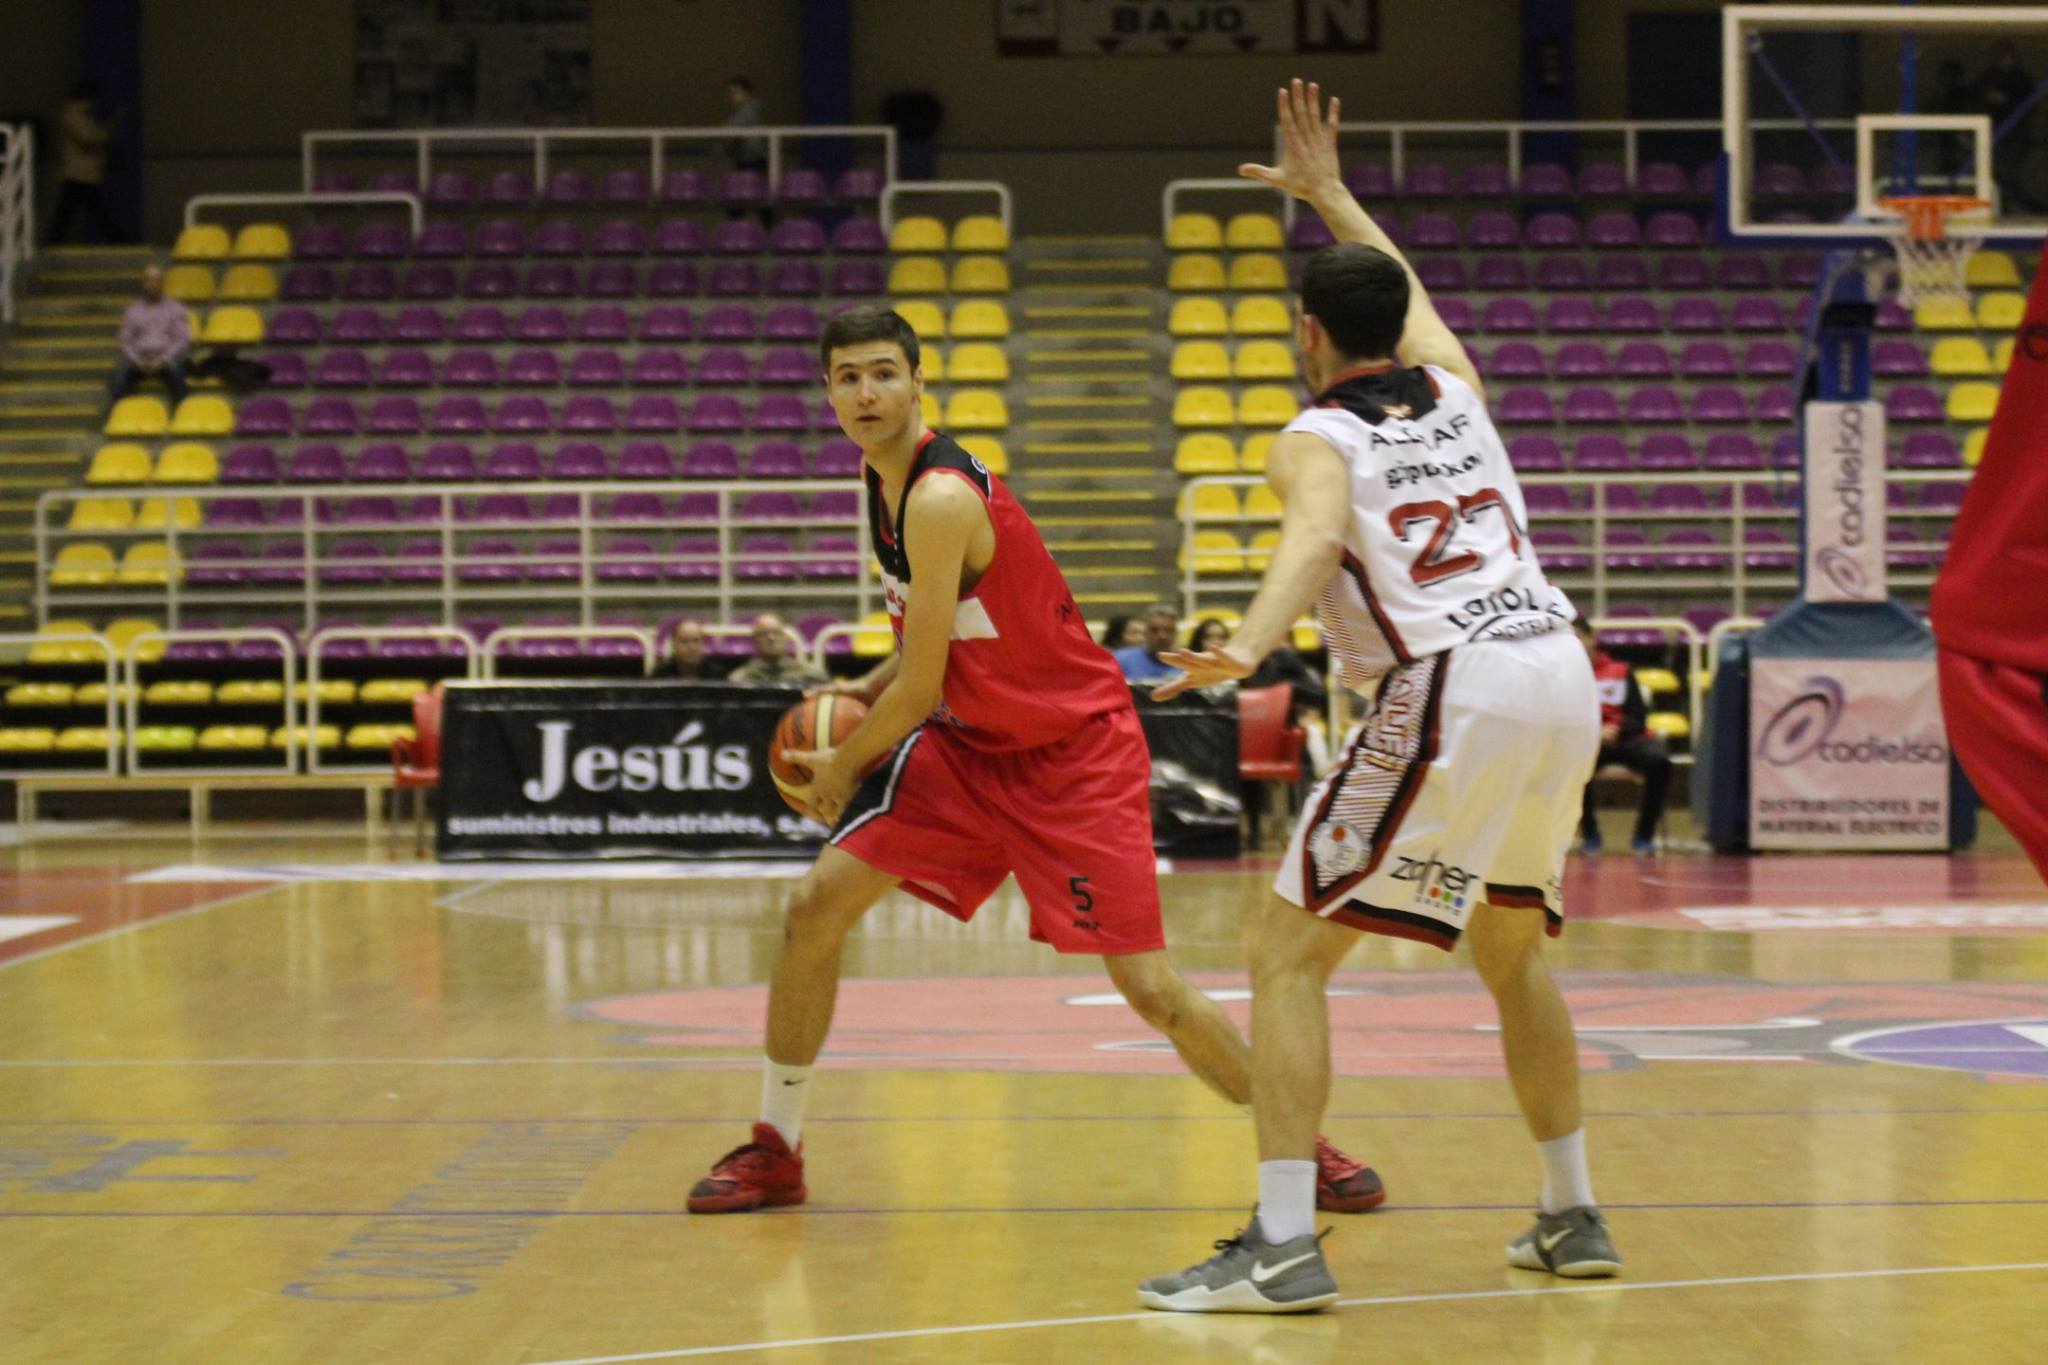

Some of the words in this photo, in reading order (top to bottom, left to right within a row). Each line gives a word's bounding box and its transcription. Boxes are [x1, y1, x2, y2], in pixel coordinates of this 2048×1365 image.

[1111, 6, 1243, 33] BAJO
[1388, 487, 1525, 588] 27
[522, 720, 754, 802] Jesús
[447, 812, 602, 836] suministros
[607, 812, 772, 838] industriales,
[1069, 876, 1094, 913] 5
